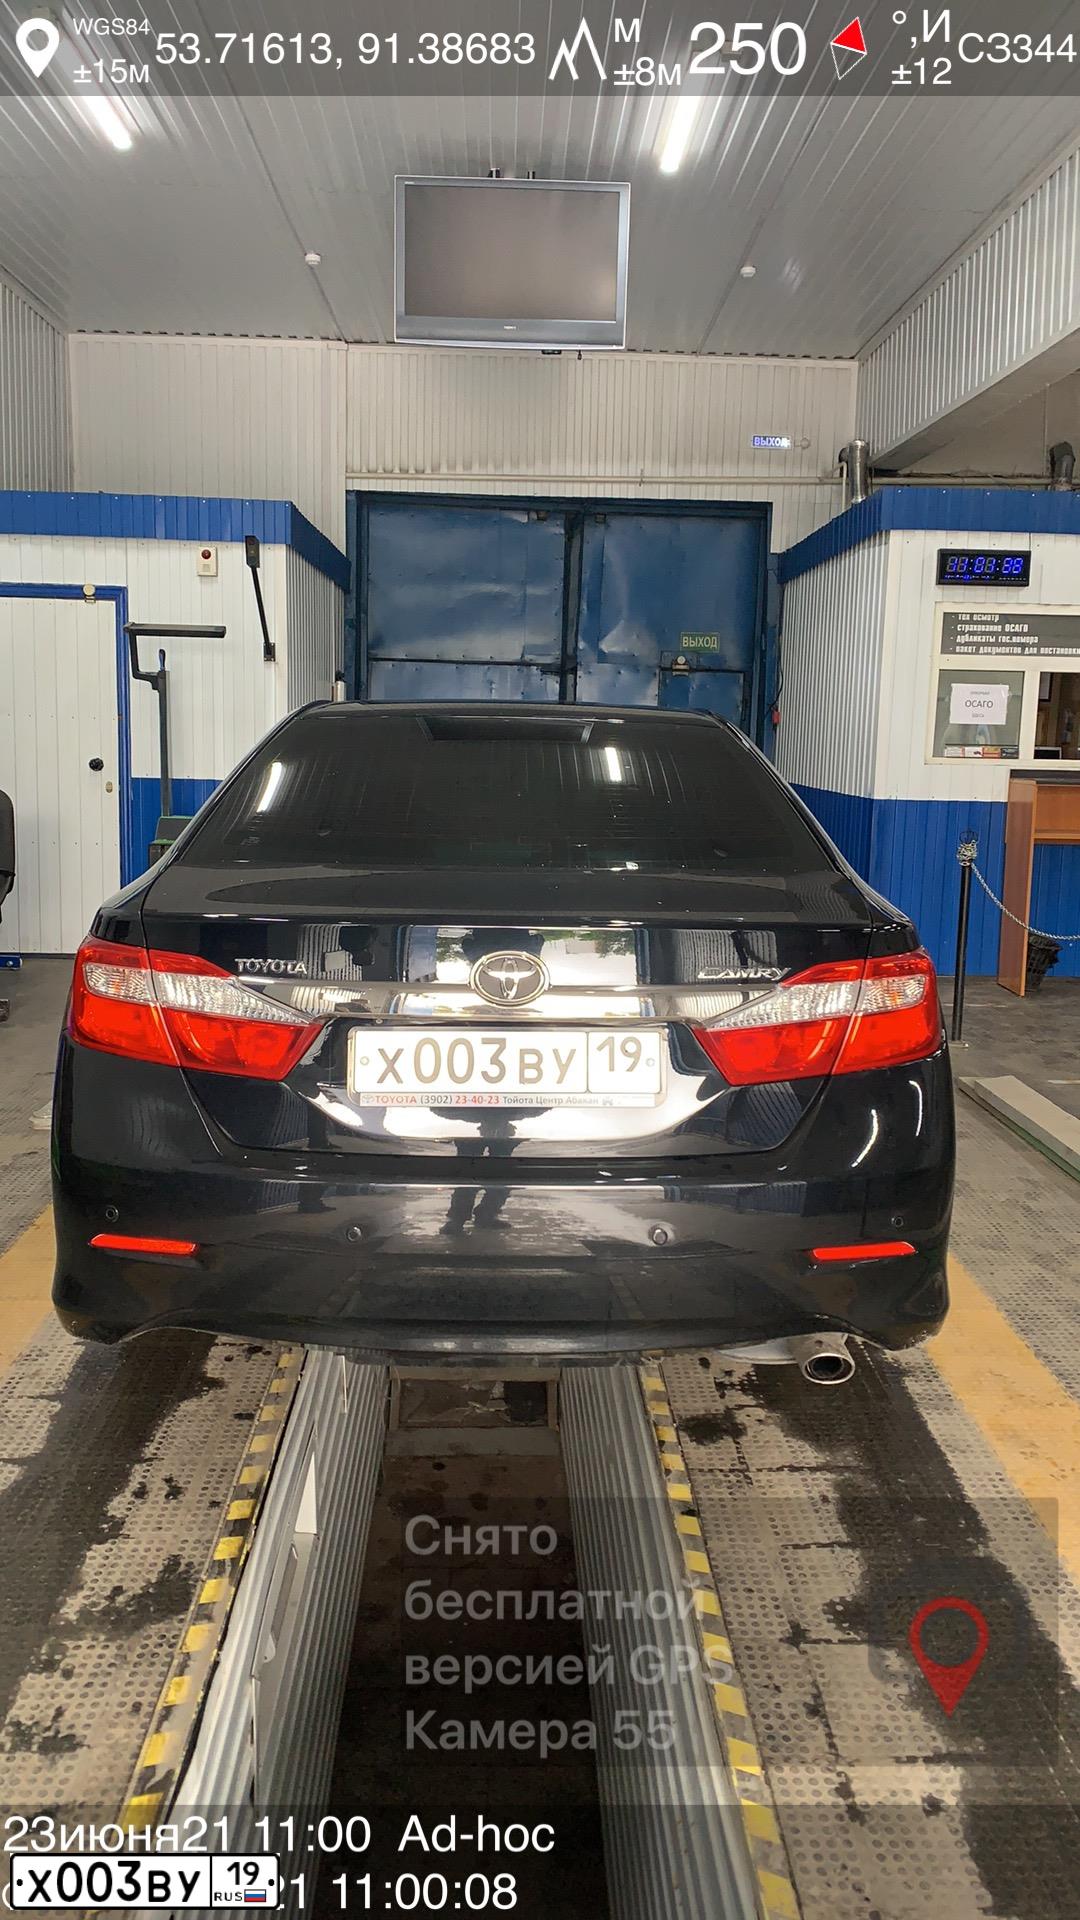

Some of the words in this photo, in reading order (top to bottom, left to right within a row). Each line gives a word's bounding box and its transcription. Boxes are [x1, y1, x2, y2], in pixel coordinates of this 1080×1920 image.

[754, 436, 788, 447] ВЫХОД
[1005, 624, 1029, 632] ОСАГО
[682, 635, 718, 649] ВЫХОД
[965, 700, 994, 708] ОСАГО
[234, 958, 308, 974] TOYOTA
[697, 966, 792, 981] CAMRY
[596, 1036, 642, 1073] 19
[375, 1095, 417, 1104] TOYOTA
[420, 1095, 453, 1106] (3902)
[455, 1095, 500, 1105] 23-40-23
[503, 1095, 534, 1105] Тойота
[536, 1096, 563, 1106] Центр
